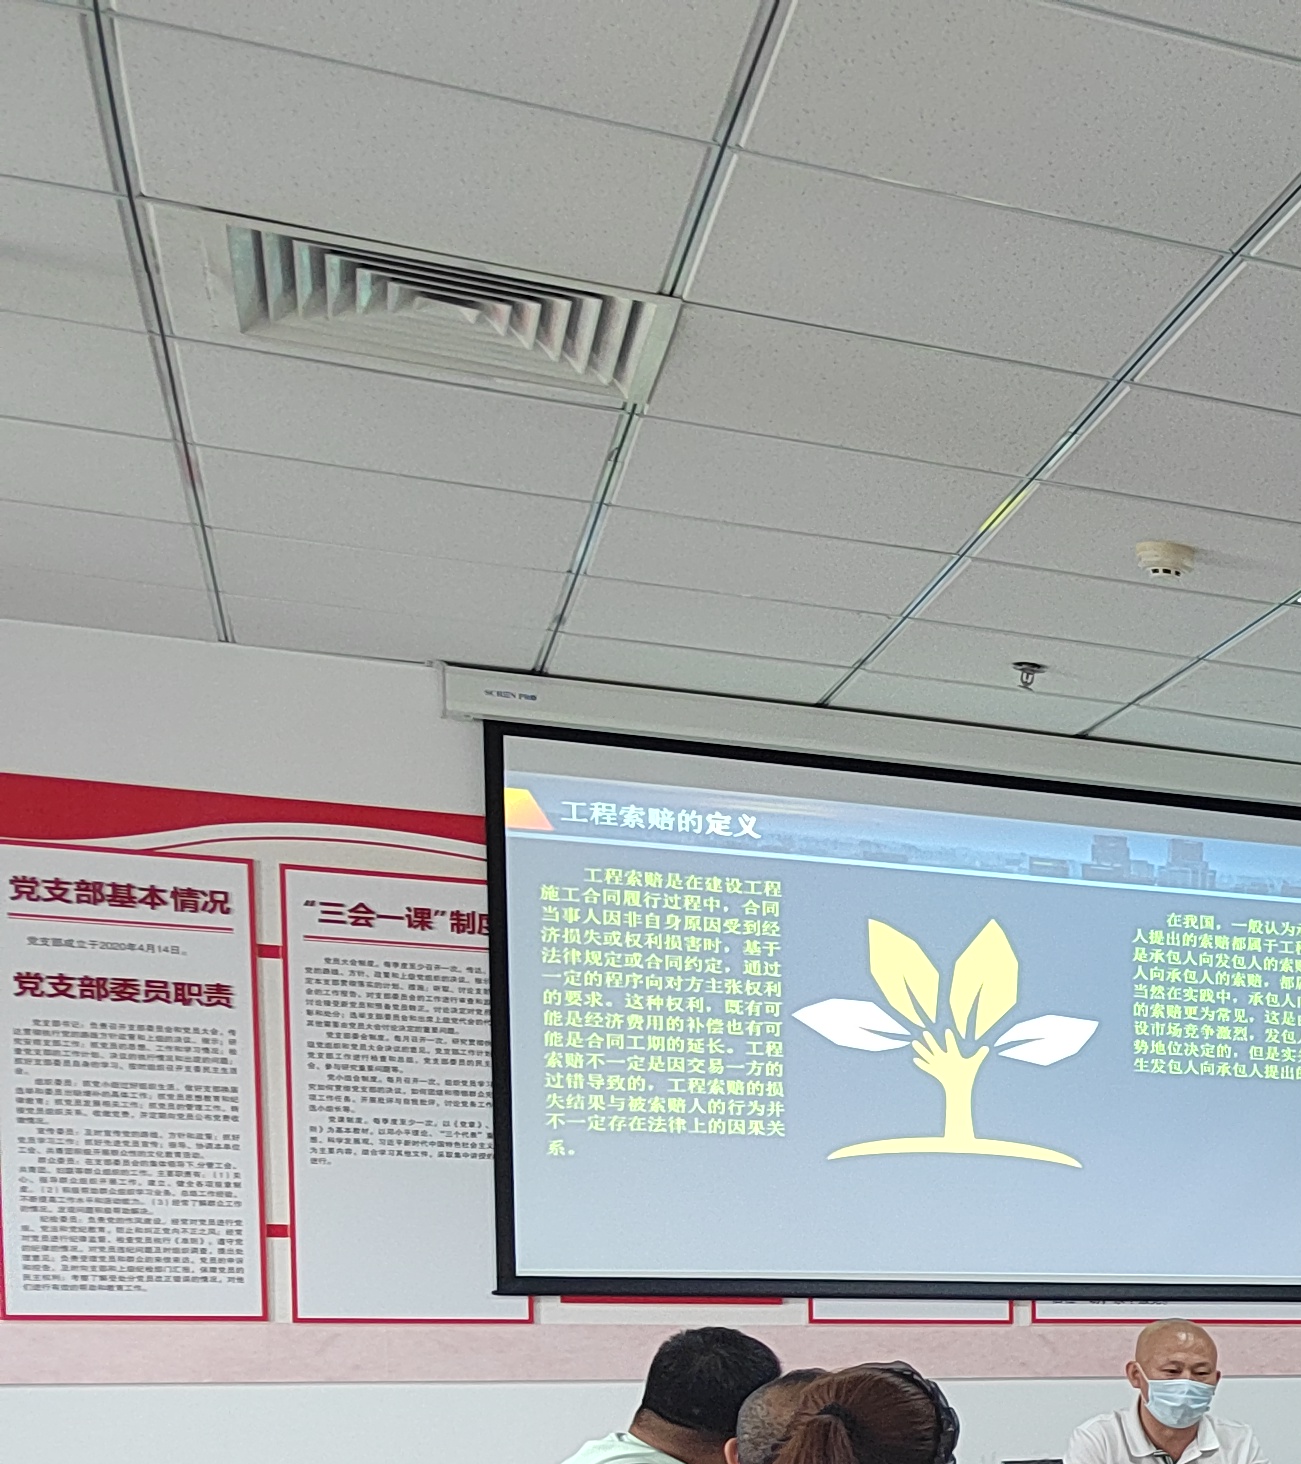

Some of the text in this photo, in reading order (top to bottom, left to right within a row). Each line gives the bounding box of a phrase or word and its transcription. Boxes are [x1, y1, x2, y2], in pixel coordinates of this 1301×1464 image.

[560, 800, 762, 839] 工程索赔的定义
[9, 875, 232, 915] 党支部基本情况
[12, 971, 235, 1009] 党支部委员职责
